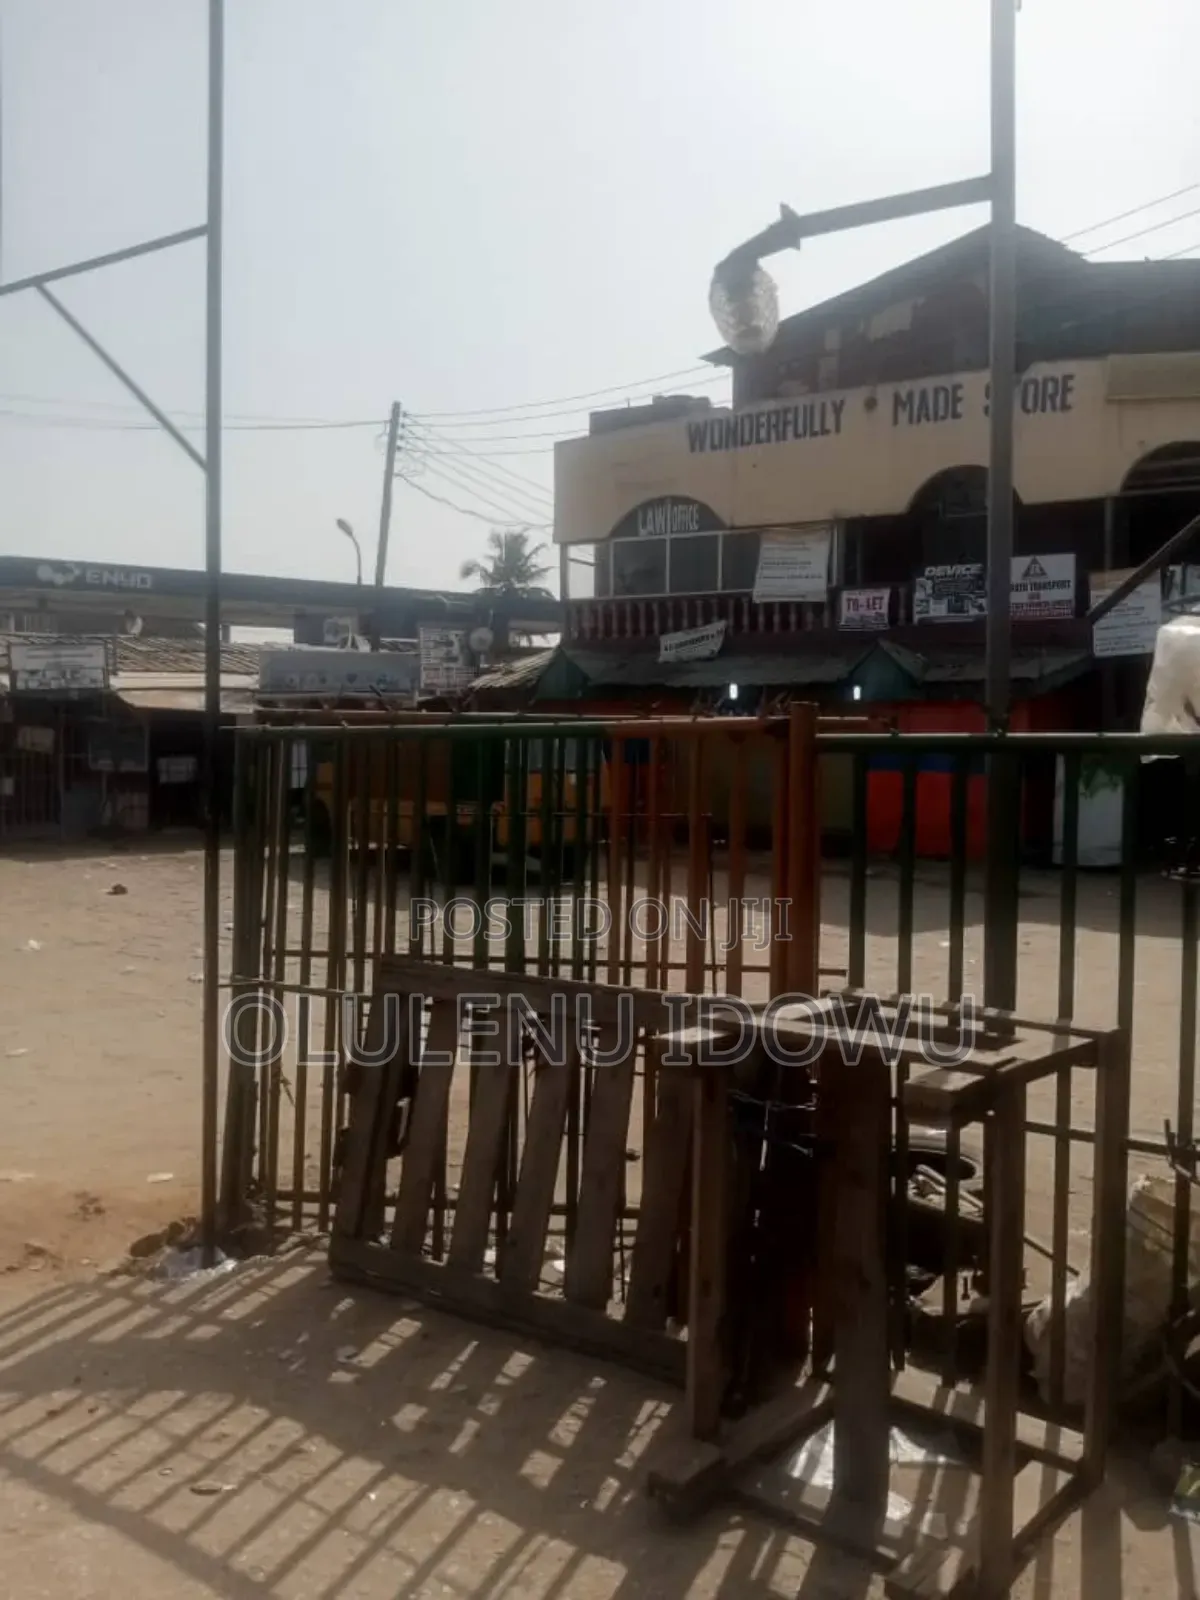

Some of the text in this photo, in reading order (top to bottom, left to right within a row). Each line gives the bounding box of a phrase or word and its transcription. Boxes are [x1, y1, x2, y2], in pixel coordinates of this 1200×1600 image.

[687, 399, 845, 453] WONDERFULLY
[892, 383, 963, 424] MADE
[638, 504, 700, 536] LAW OFFICE
[85, 569, 153, 588] ENYO
[924, 564, 984, 578] DEVICE
